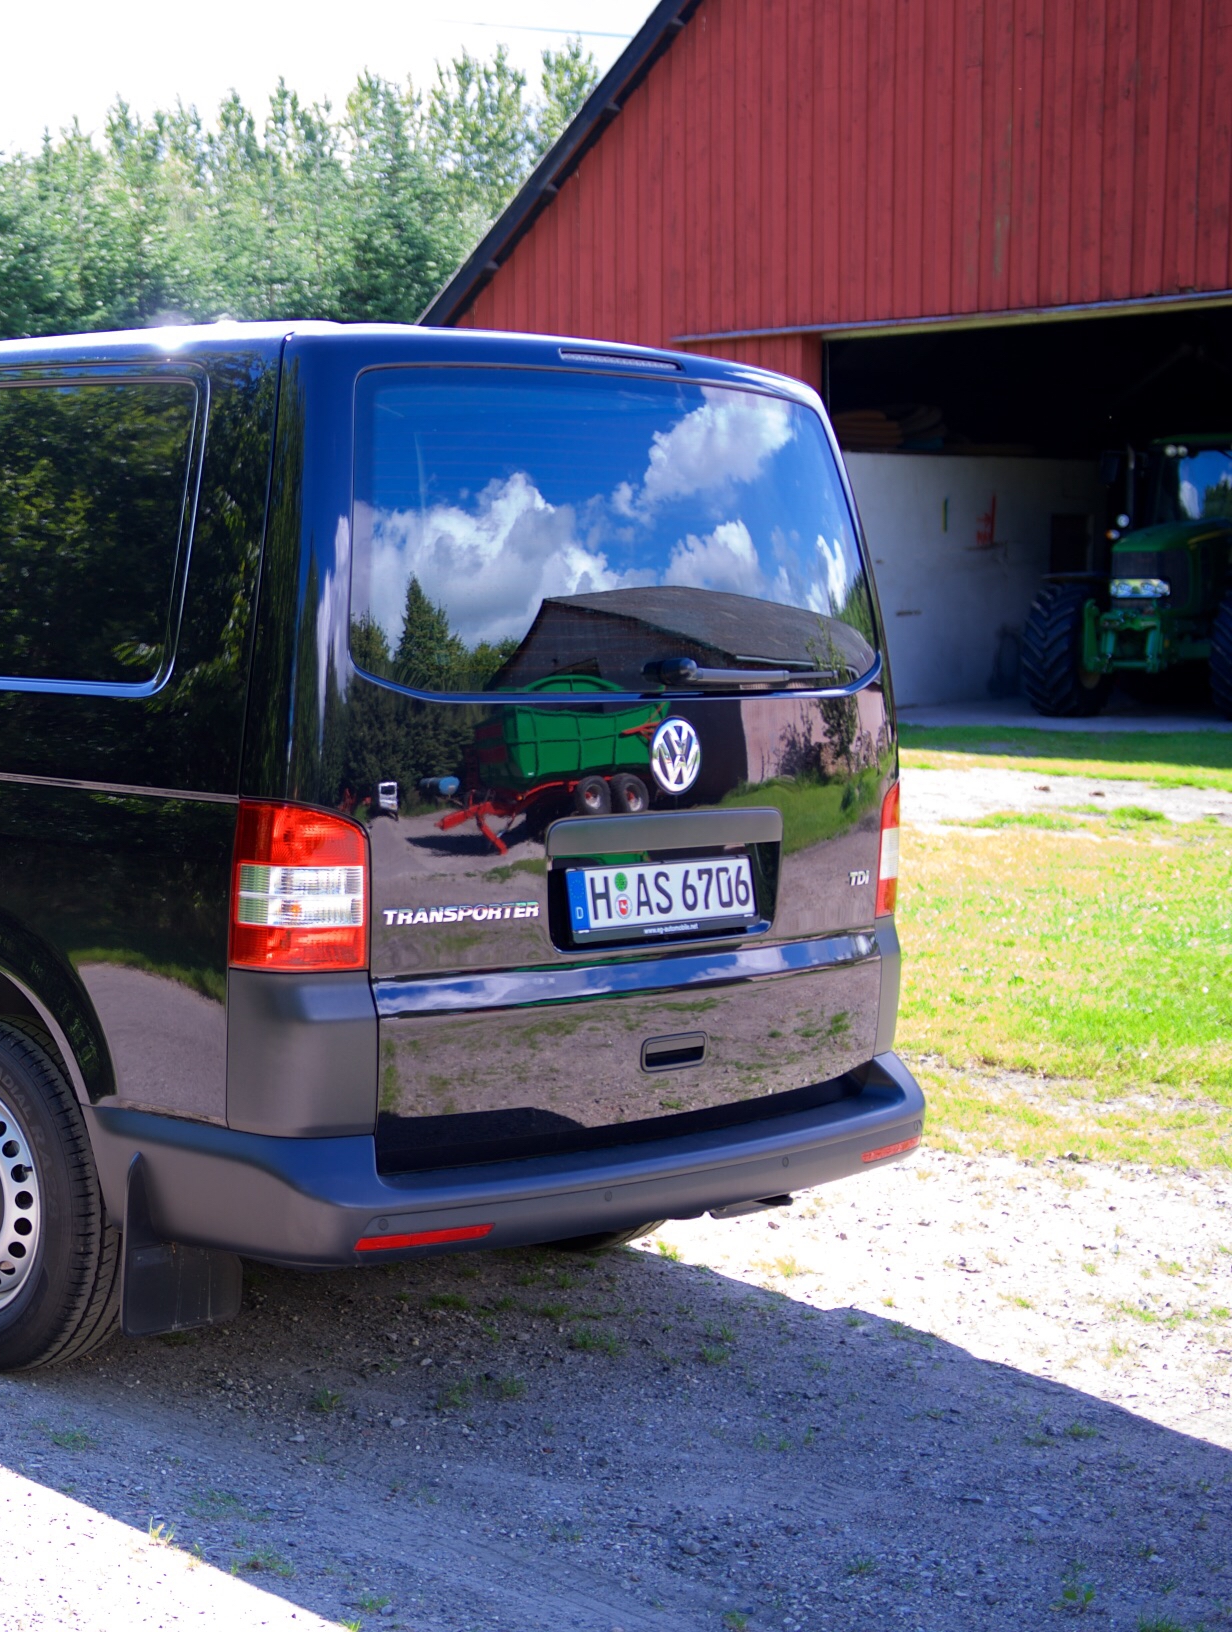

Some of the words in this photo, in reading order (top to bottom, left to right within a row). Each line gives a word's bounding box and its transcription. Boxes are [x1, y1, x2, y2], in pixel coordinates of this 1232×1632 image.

[849, 869, 870, 886] TDI
[590, 875, 612, 920] H
[637, 871, 673, 916] AS
[682, 866, 750, 912] 6706
[382, 901, 540, 926] TRANSPORTER
[576, 906, 584, 919] D
